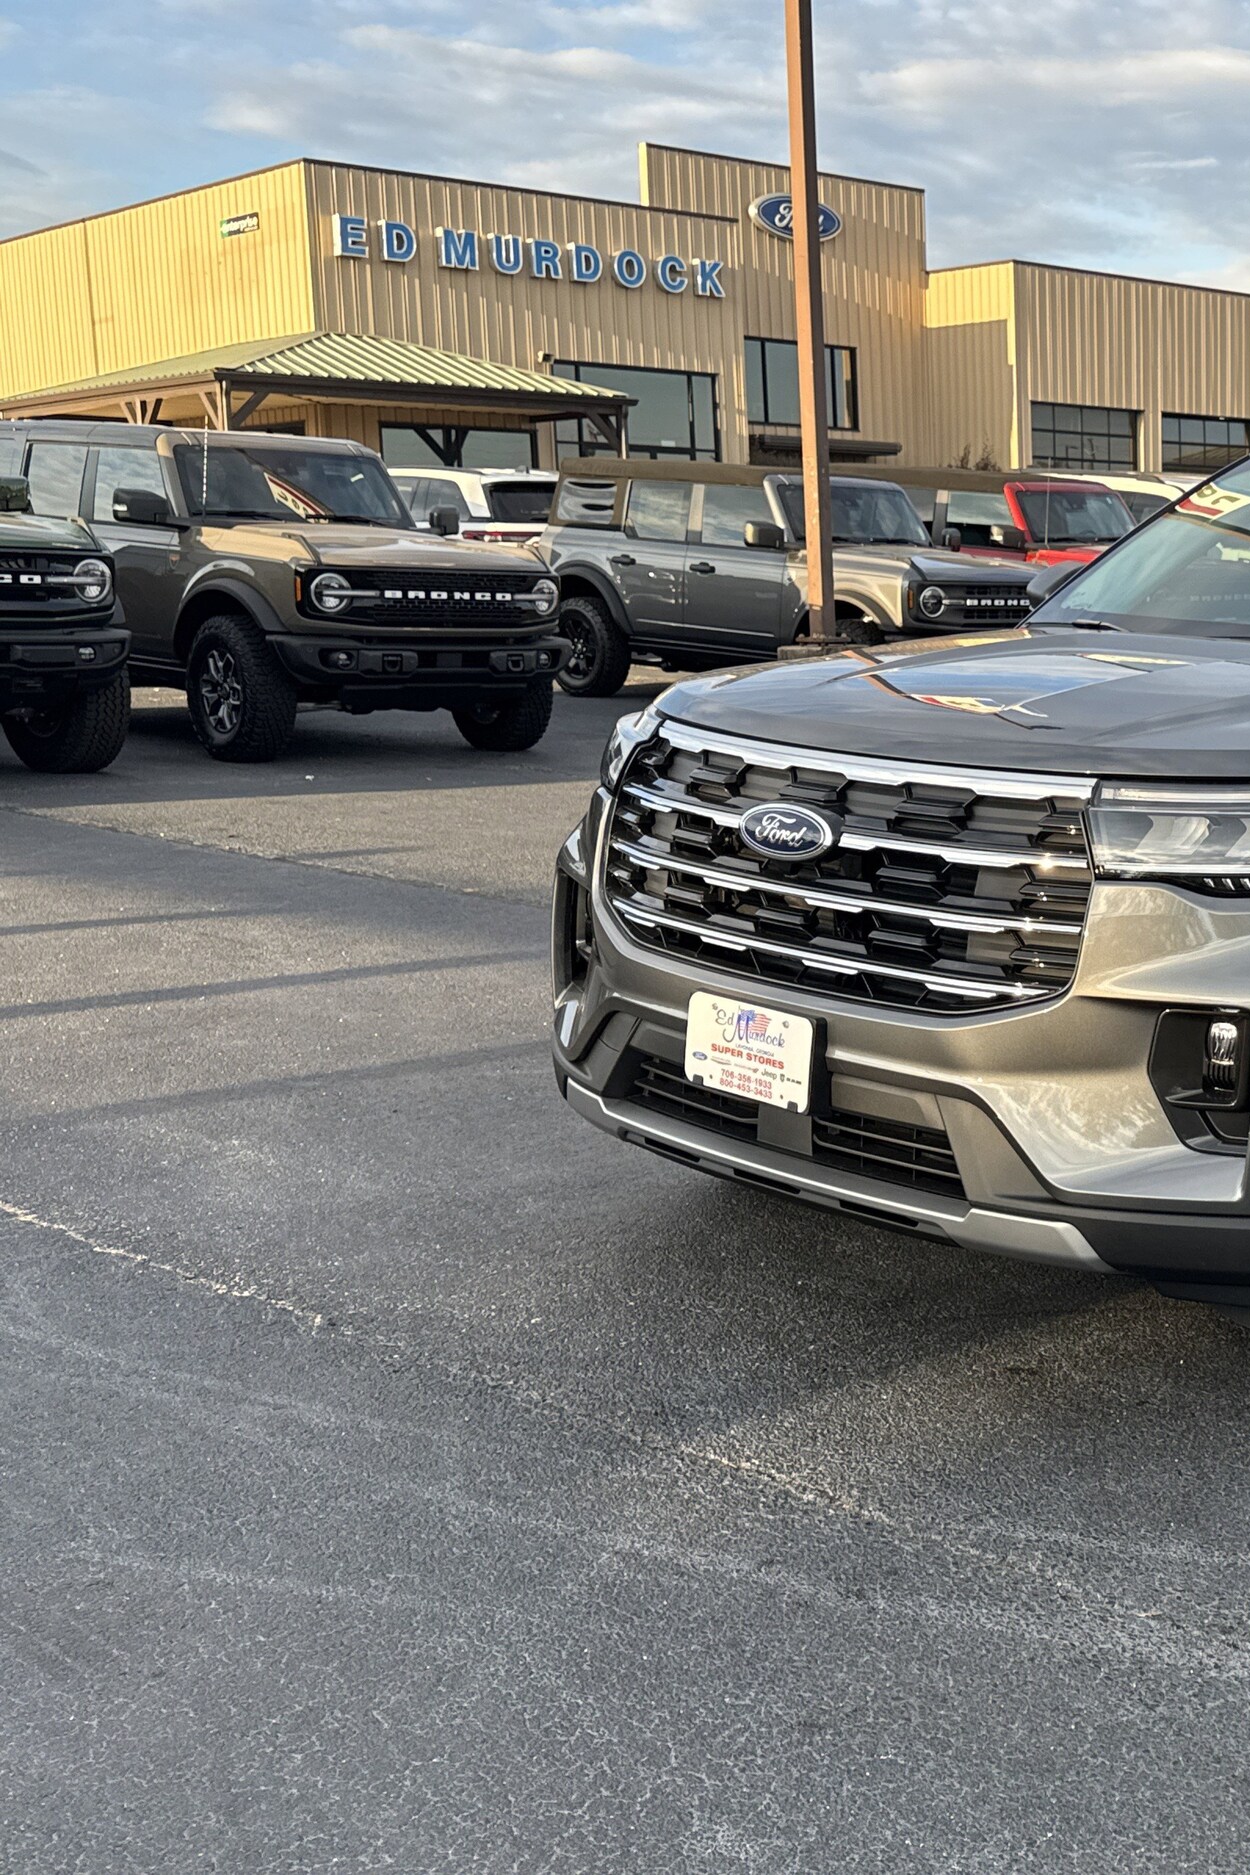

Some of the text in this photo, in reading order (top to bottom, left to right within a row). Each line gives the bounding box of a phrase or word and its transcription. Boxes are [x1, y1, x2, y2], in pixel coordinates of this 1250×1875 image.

[333, 213, 727, 298] ED MURDOCK
[384, 590, 512, 601] BRONCO
[755, 813, 807, 847] Ford
[715, 1009, 735, 1026] Ed
[711, 1043, 743, 1059] SUPER
[746, 1052, 784, 1070] STORES
